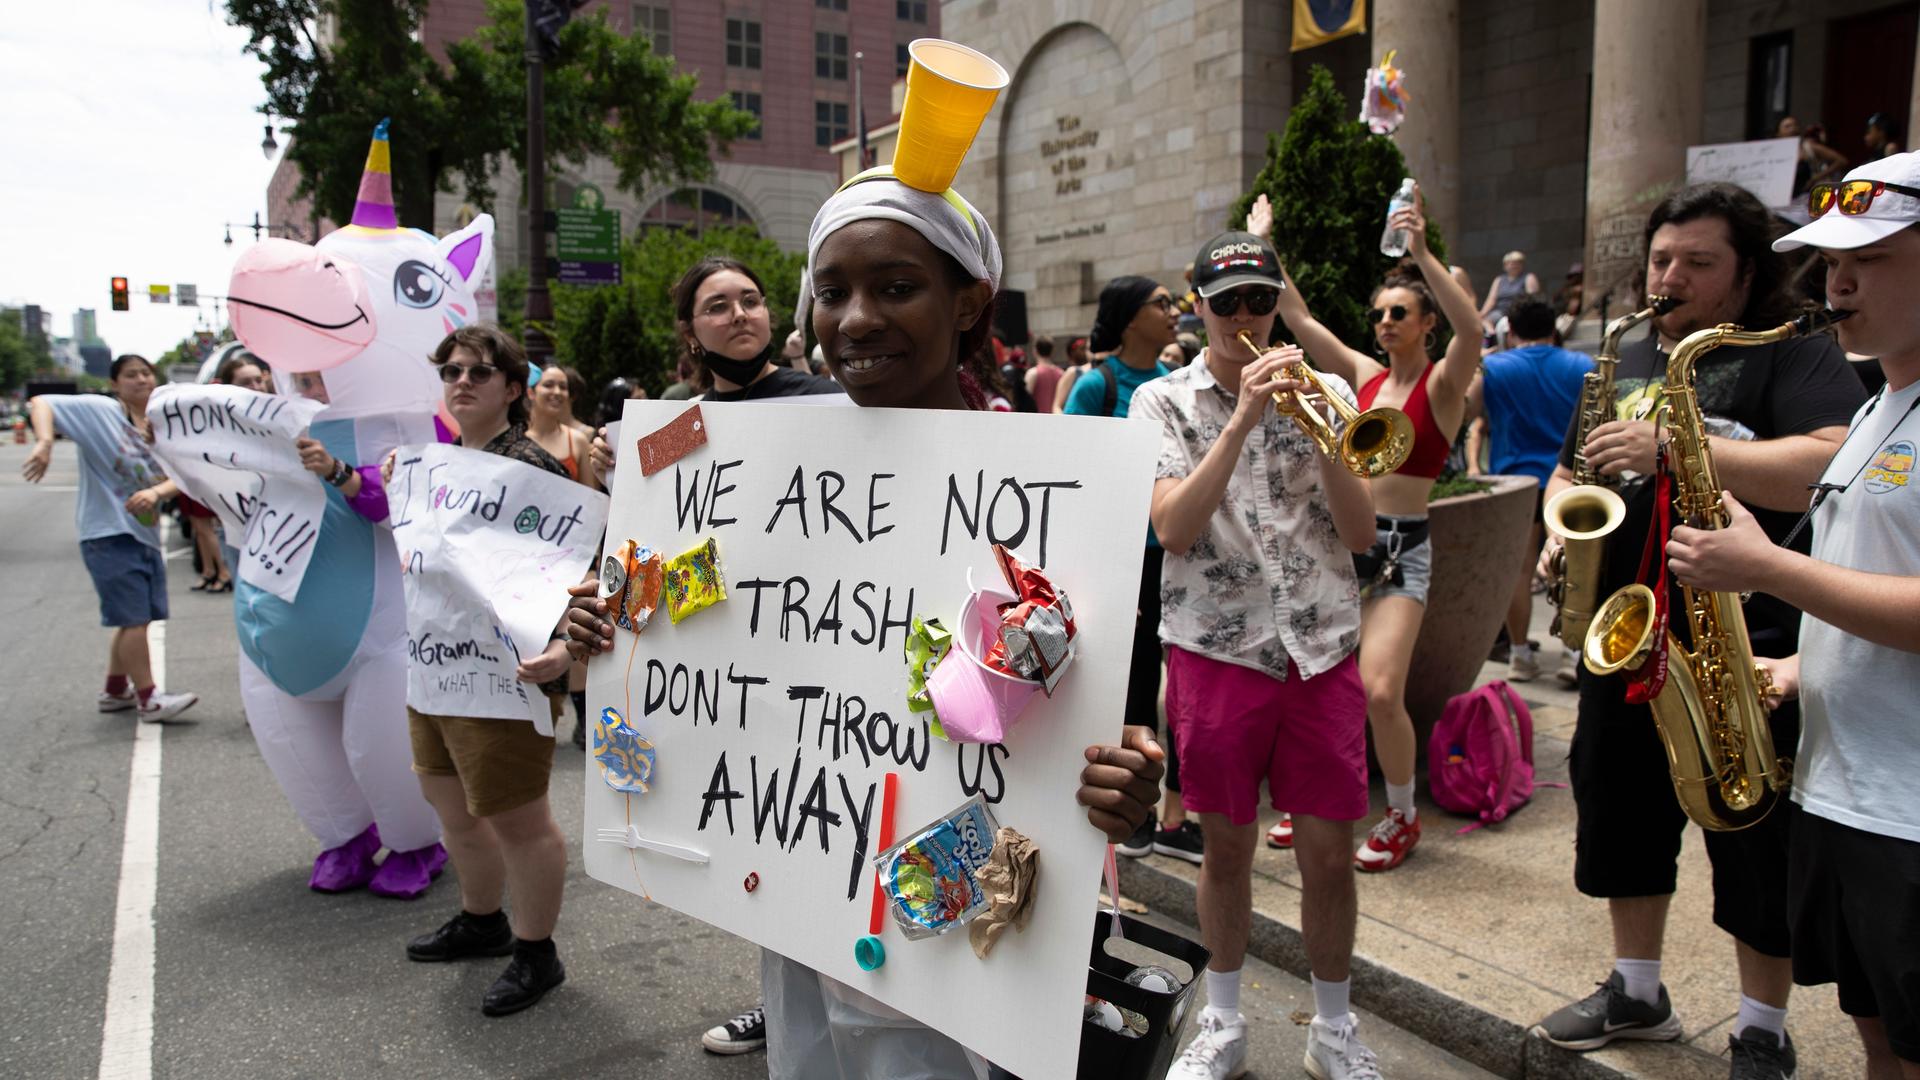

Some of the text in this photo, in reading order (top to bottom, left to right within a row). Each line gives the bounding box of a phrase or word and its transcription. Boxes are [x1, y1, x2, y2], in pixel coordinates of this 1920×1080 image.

[1056, 114, 1081, 133] The
[1041, 130, 1099, 159] University
[1051, 156, 1087, 176] of the
[1056, 177, 1082, 195] Arts
[163, 396, 288, 440] HONK!!!
[392, 457, 422, 529] I
[426, 462, 507, 522] Found
[676, 460, 1082, 569] WE ARE NOT
[736, 576, 914, 664] TRASH
[407, 632, 500, 666] aGram...
[438, 672, 478, 694] WHAT
[488, 672, 512, 696] THE
[645, 659, 1010, 804] DON'T THROW US
[698, 747, 877, 902] AWAY
